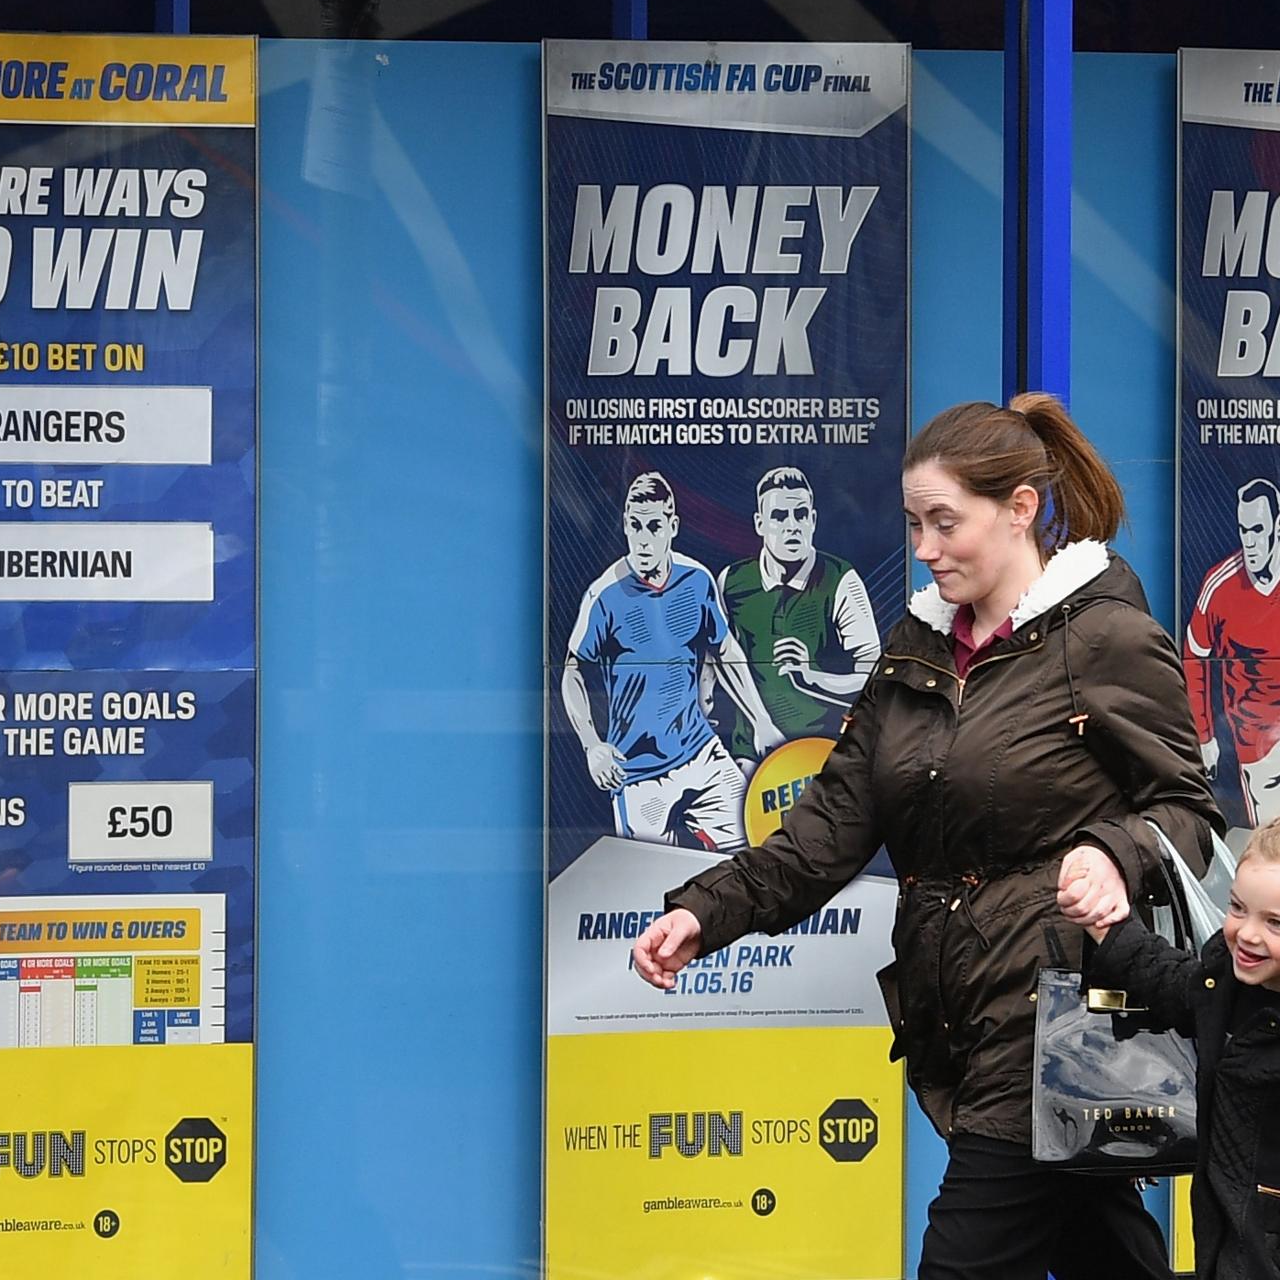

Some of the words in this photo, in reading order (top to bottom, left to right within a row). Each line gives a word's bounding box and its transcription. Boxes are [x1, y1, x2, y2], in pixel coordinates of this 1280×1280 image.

[69, 78, 95, 100] AT
[100, 63, 228, 102] CORAL
[571, 72, 595, 90] THE
[598, 62, 720, 92] SCOTTISH
[726, 64, 756, 92] FA
[764, 65, 822, 92] CUP
[824, 75, 870, 92] FINAL
[1243, 82, 1274, 104] THE
[63, 168, 207, 217] WAYS
[569, 184, 879, 274] MONEY
[31, 228, 203, 310] WIN
[588, 286, 828, 377] BACK
[47, 343, 97, 372] BET
[105, 343, 145, 372] ON
[566, 400, 588, 419] ON
[590, 400, 645, 419] LOSING
[649, 399, 697, 419] FIRST
[700, 398, 825, 419] GOALSCORER
[829, 398, 879, 418] BETS
[1197, 401, 1219, 420] ON
[1220, 400, 1273, 420] LOSING
[1201, 425, 1214, 444] IF
[1217, 425, 1242, 444] THE
[2, 480, 35, 508] TO
[40, 480, 104, 508] BEAT
[14, 693, 93, 721] MORE
[102, 692, 196, 720] GOALS
[4, 729, 54, 756] THE
[63, 727, 145, 755] GAME
[108, 806, 172, 838] £50
[0, 923, 43, 941] TEAM
[47, 923, 67, 940] TO
[72, 922, 107, 939] WIN
[111, 922, 124, 938] &
[128, 921, 187, 938] OVERS
[737, 945, 794, 967] PARK
[1083, 1108, 1113, 1120] TED
[1125, 1106, 1176, 1118] BAKER
[564, 1126, 607, 1150] WHEN
[614, 1124, 641, 1148] THE
[648, 1111, 743, 1159] FUN
[752, 1120, 810, 1144] STOPS
[823, 1118, 874, 1144] STOP
[94, 1140, 156, 1164] STOPS
[169, 1139, 223, 1163] STOP
[643, 1197, 743, 1212] gambleaware.co.uk
